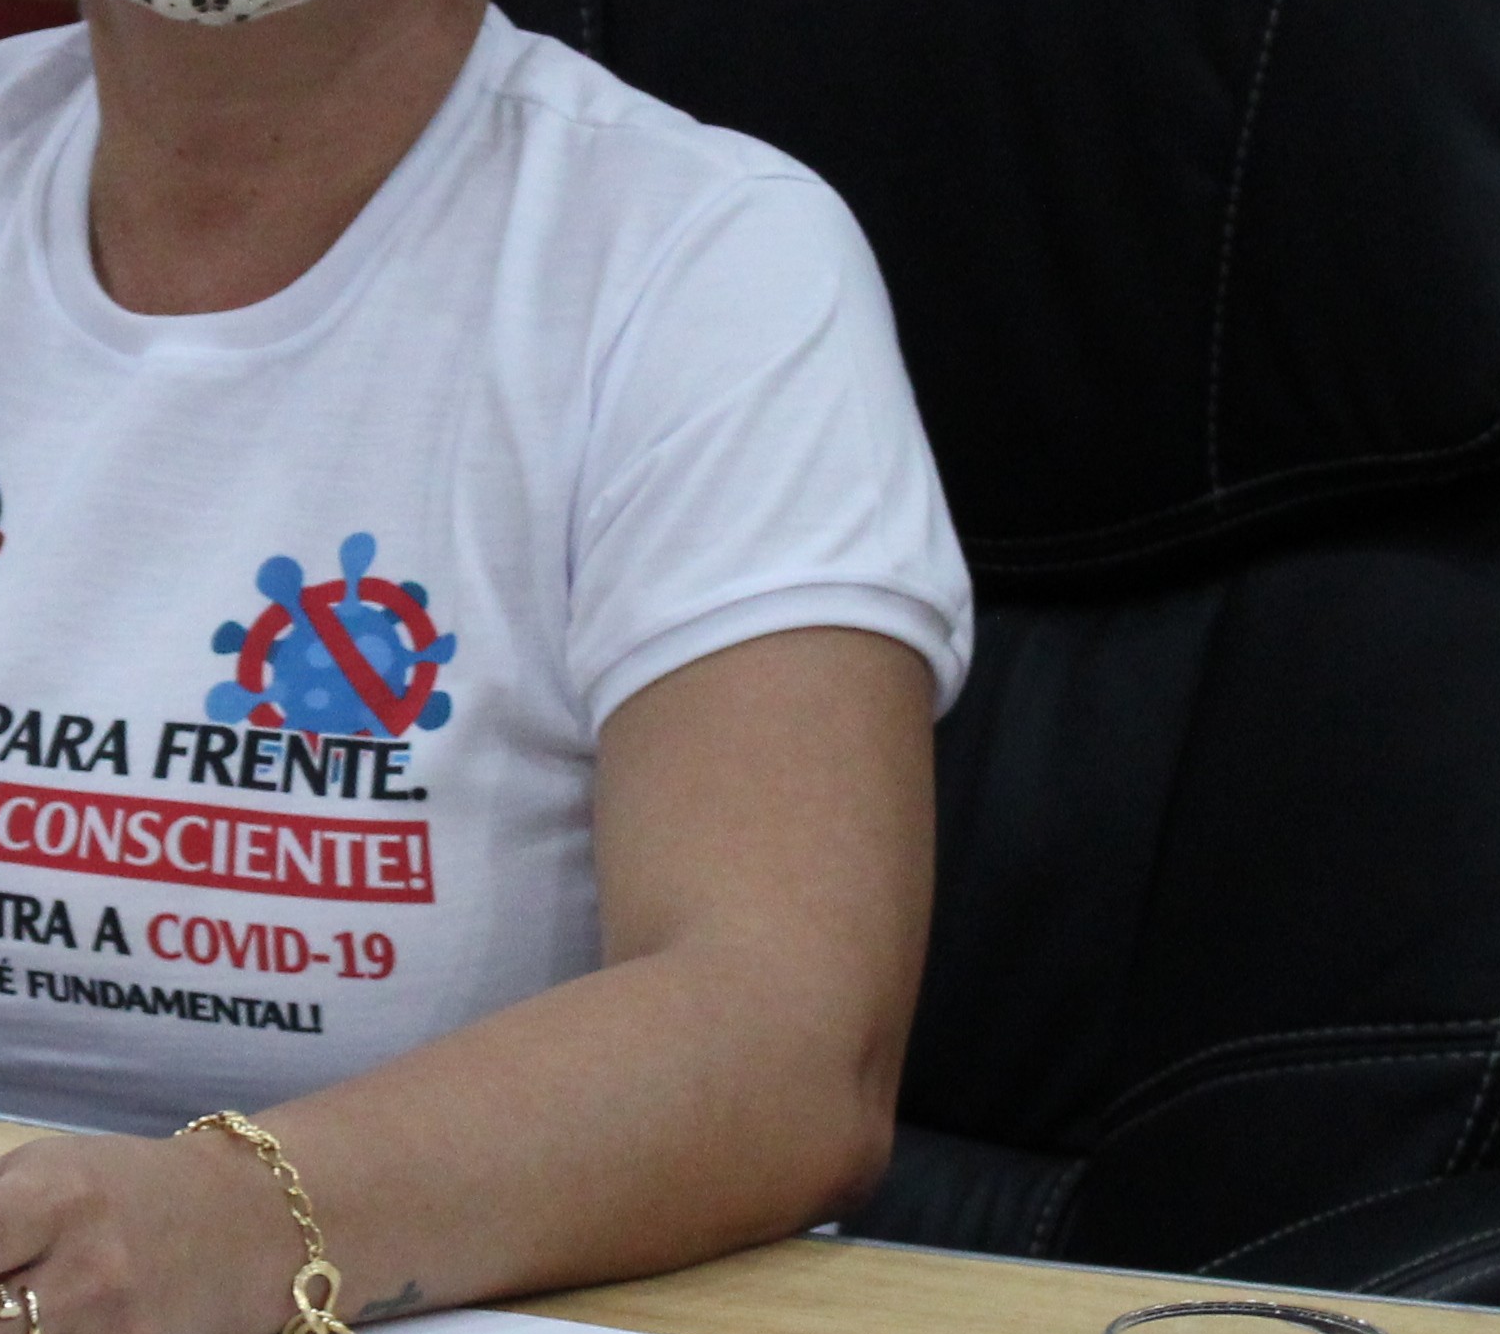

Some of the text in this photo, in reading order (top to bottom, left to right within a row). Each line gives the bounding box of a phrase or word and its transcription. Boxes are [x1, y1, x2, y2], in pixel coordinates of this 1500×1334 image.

[151, 721, 428, 801] FRENTE.
[91, 906, 132, 956] A
[145, 912, 396, 981] COVID-19
[26, 969, 323, 1035] FUNDAMENTAL!
